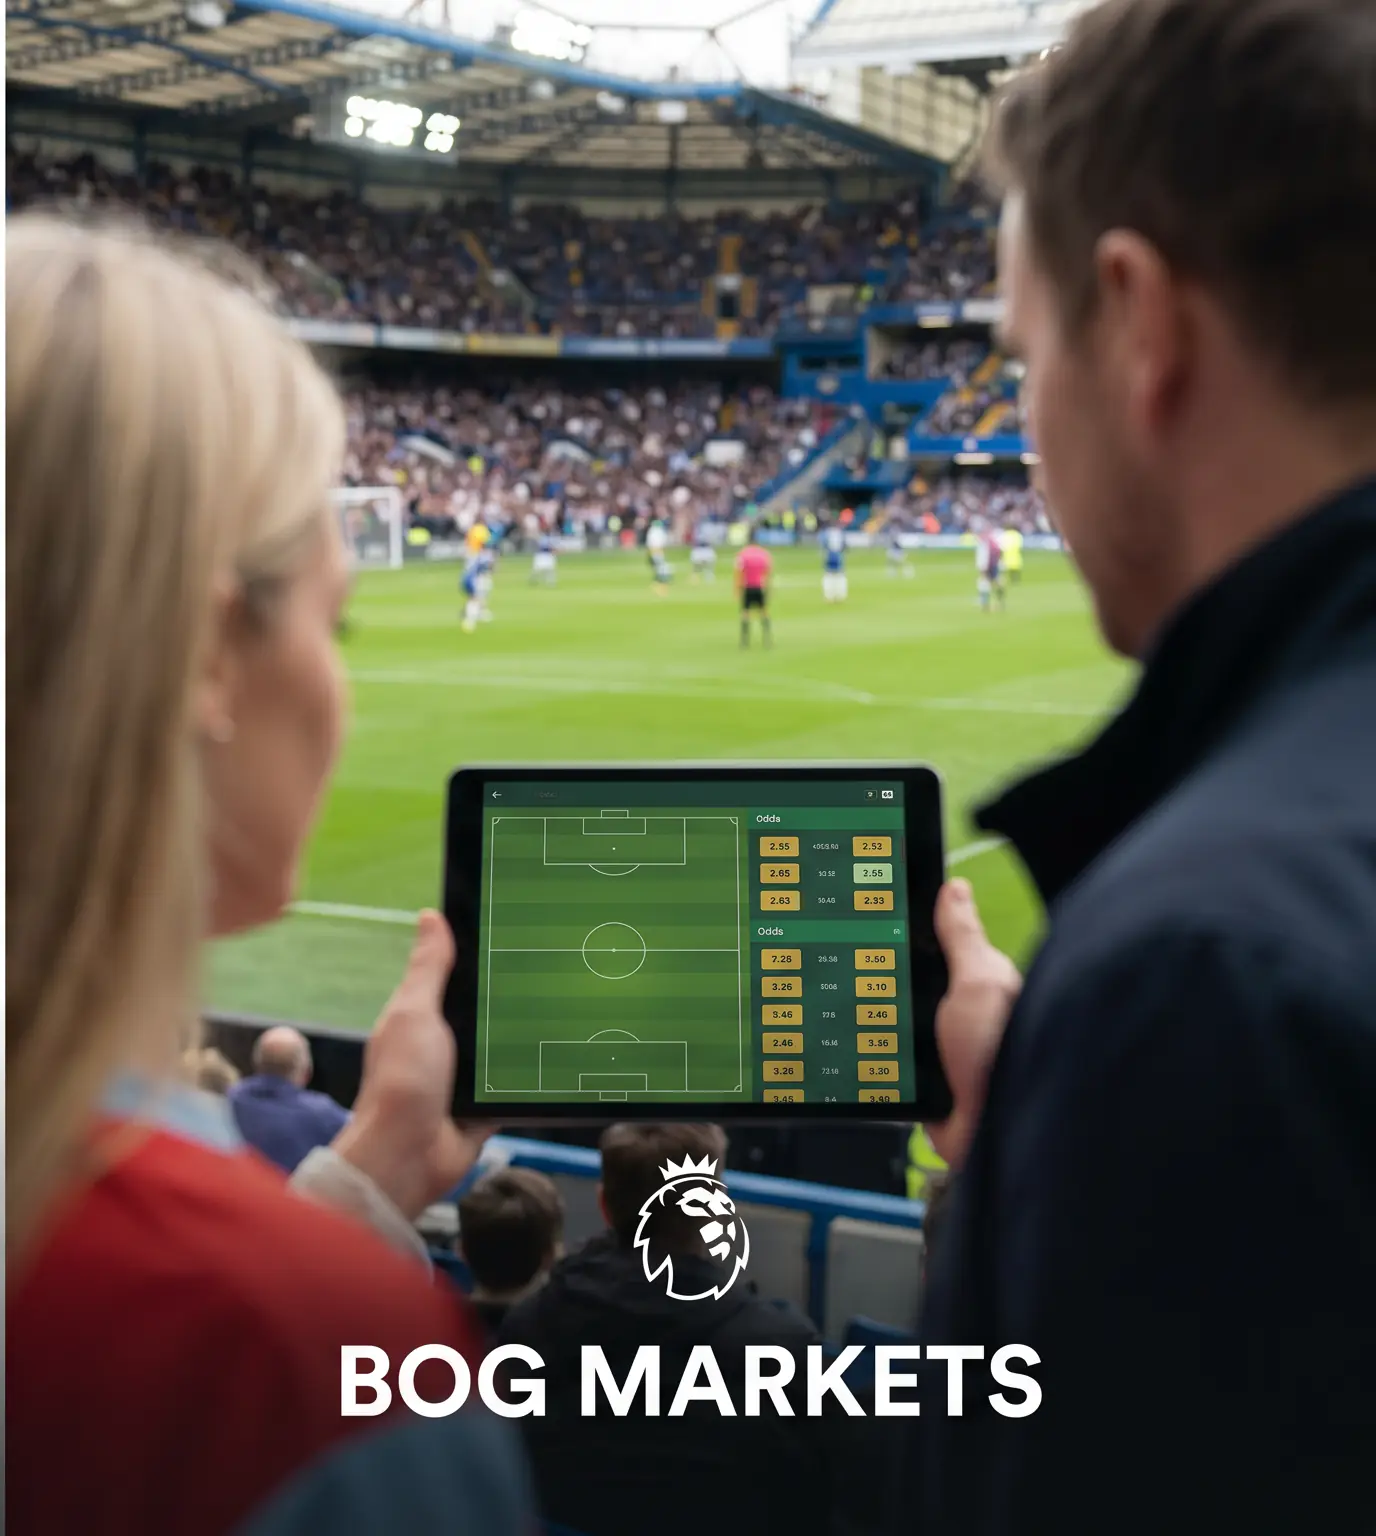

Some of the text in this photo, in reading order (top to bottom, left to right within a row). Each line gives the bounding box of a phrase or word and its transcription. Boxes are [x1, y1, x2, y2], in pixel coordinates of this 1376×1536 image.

[770, 897, 791, 905] 2.63
[758, 927, 783, 936] Odds
[865, 955, 886, 963] 3.50
[772, 983, 792, 991] 3.26
[867, 983, 887, 991] 3.10
[868, 1011, 887, 1019] 2.46
[773, 1039, 793, 1047] 2.46
